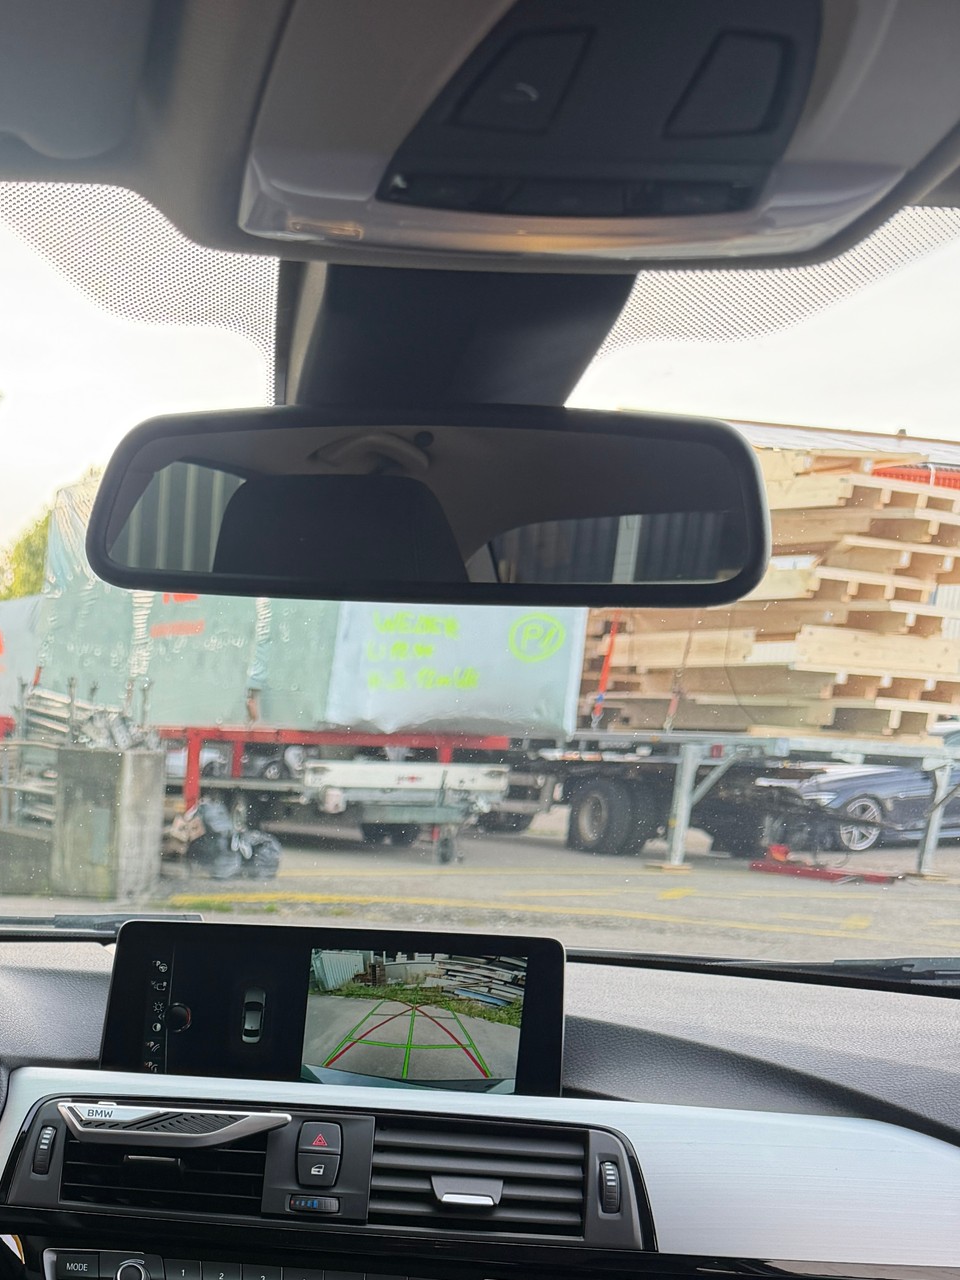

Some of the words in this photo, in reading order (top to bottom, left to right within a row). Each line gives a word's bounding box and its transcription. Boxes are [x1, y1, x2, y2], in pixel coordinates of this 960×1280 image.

[87, 1108, 113, 1118] BMW
[66, 1262, 88, 1272] MODE
[181, 1269, 186, 1277] 1
[218, 1272, 224, 1280] 2
